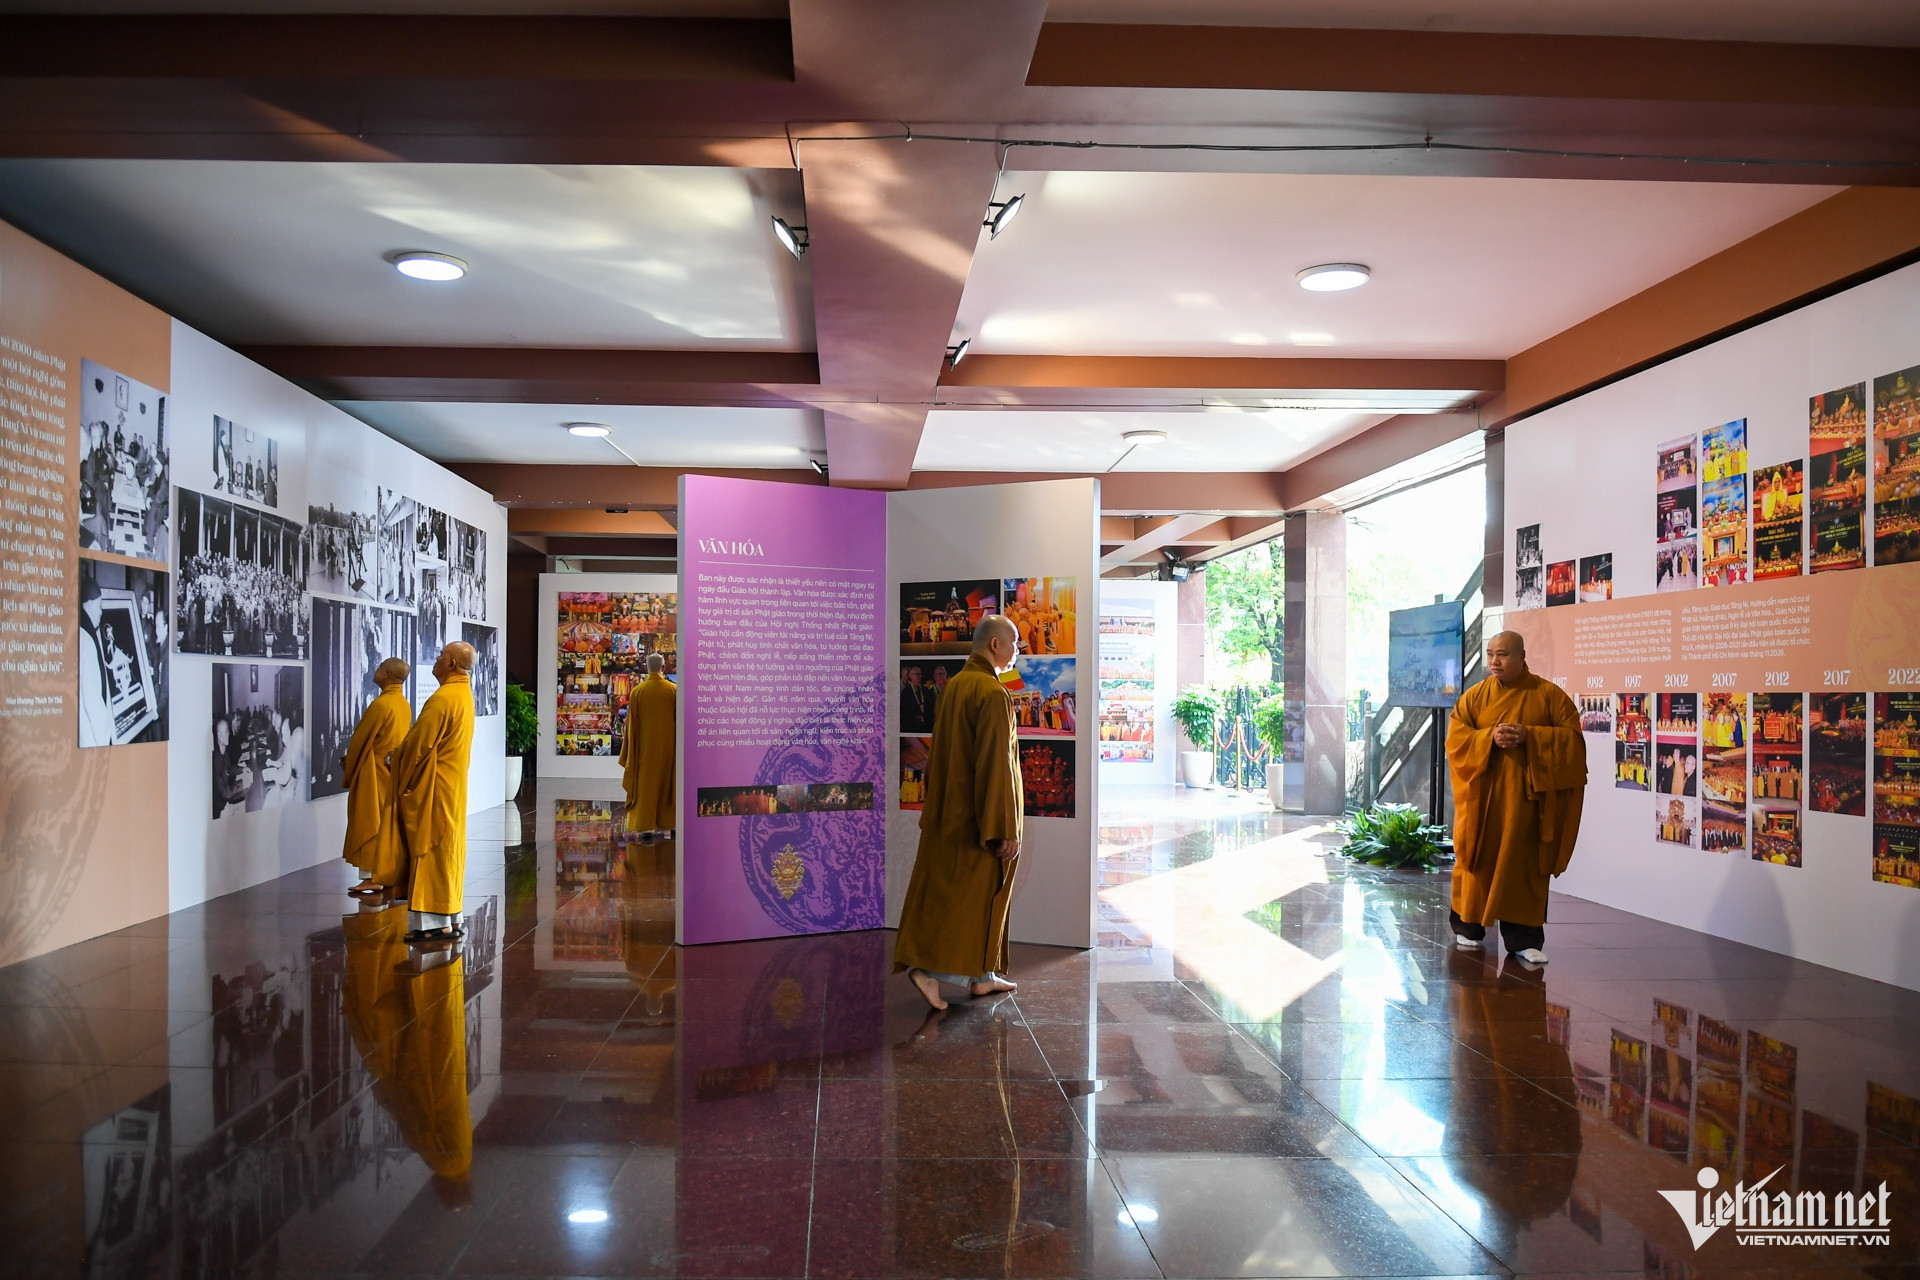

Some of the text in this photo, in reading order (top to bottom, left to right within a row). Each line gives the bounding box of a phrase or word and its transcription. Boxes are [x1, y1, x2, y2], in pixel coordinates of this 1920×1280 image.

[12, 339, 31, 356] 2000
[699, 538, 764, 556] VĂN HÓA
[802, 578, 813, 586] yếu
[712, 608, 722, 616] giá
[698, 618, 720, 626] hướng
[802, 621, 822, 629] Thống
[1586, 676, 1603, 688] 1992
[1625, 675, 1642, 688] 1997
[1664, 674, 1688, 687] 2002
[1712, 673, 1737, 687] 2007
[1765, 672, 1790, 686] 2012
[1824, 670, 1850, 685] 2017
